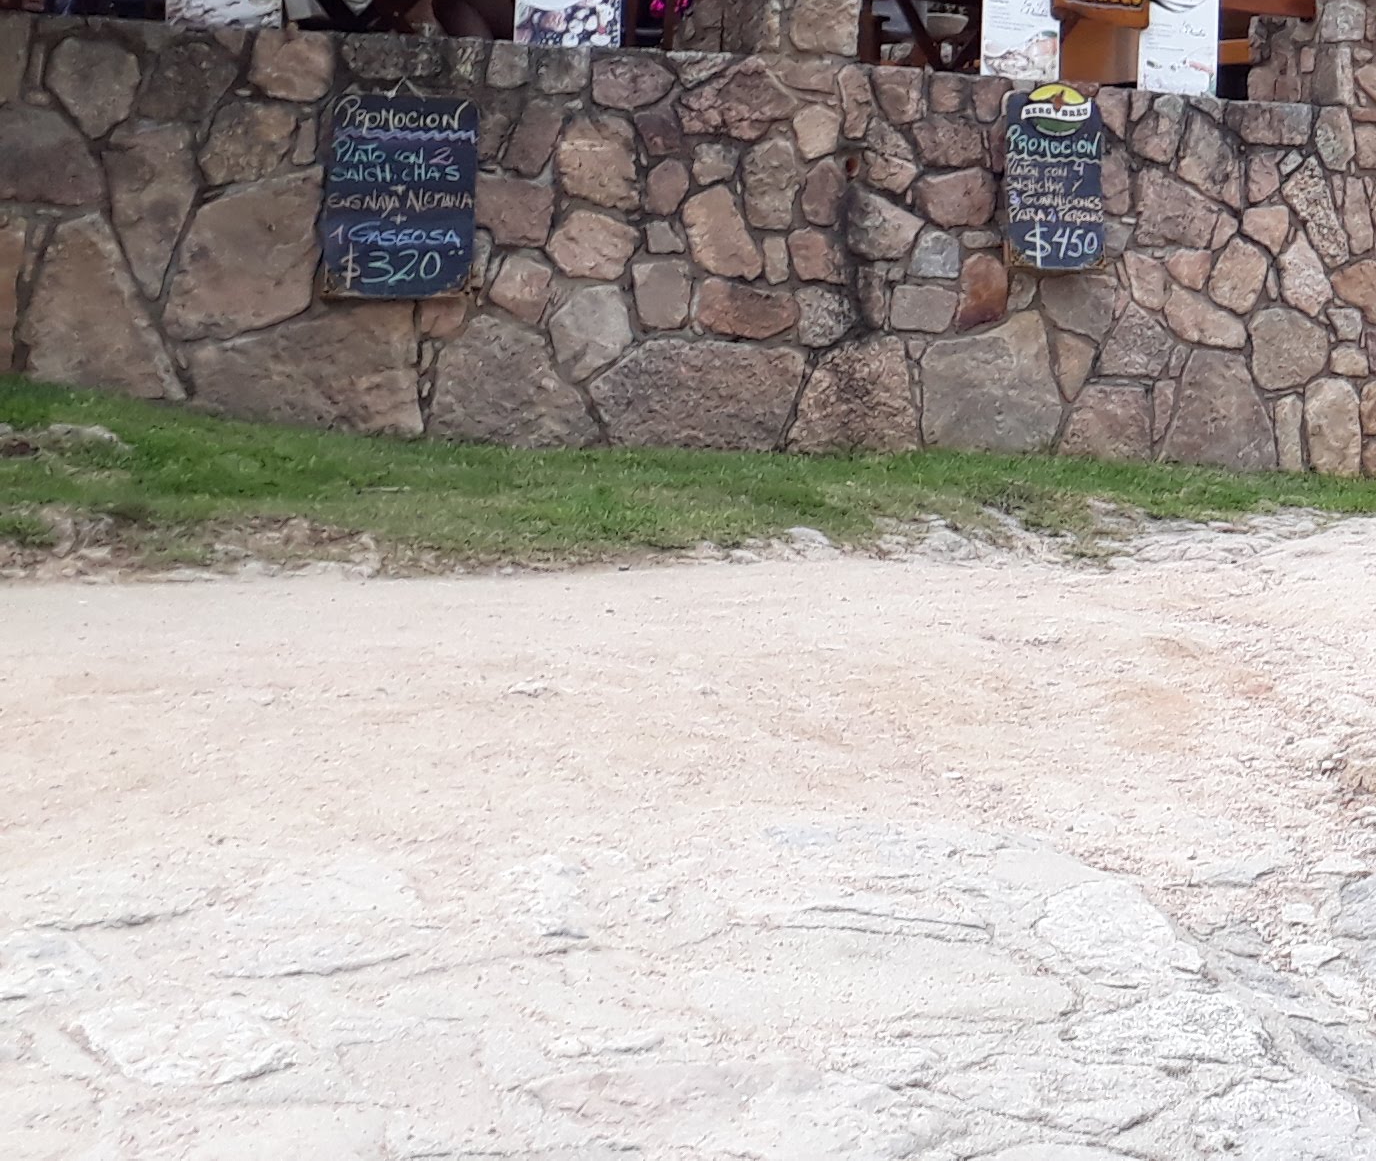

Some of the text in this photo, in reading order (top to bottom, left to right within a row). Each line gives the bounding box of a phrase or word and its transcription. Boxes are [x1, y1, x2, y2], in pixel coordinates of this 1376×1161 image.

[428, 146, 454, 165] 2
[348, 220, 462, 248] GASEOSA
[1024, 221, 1099, 268] $450
